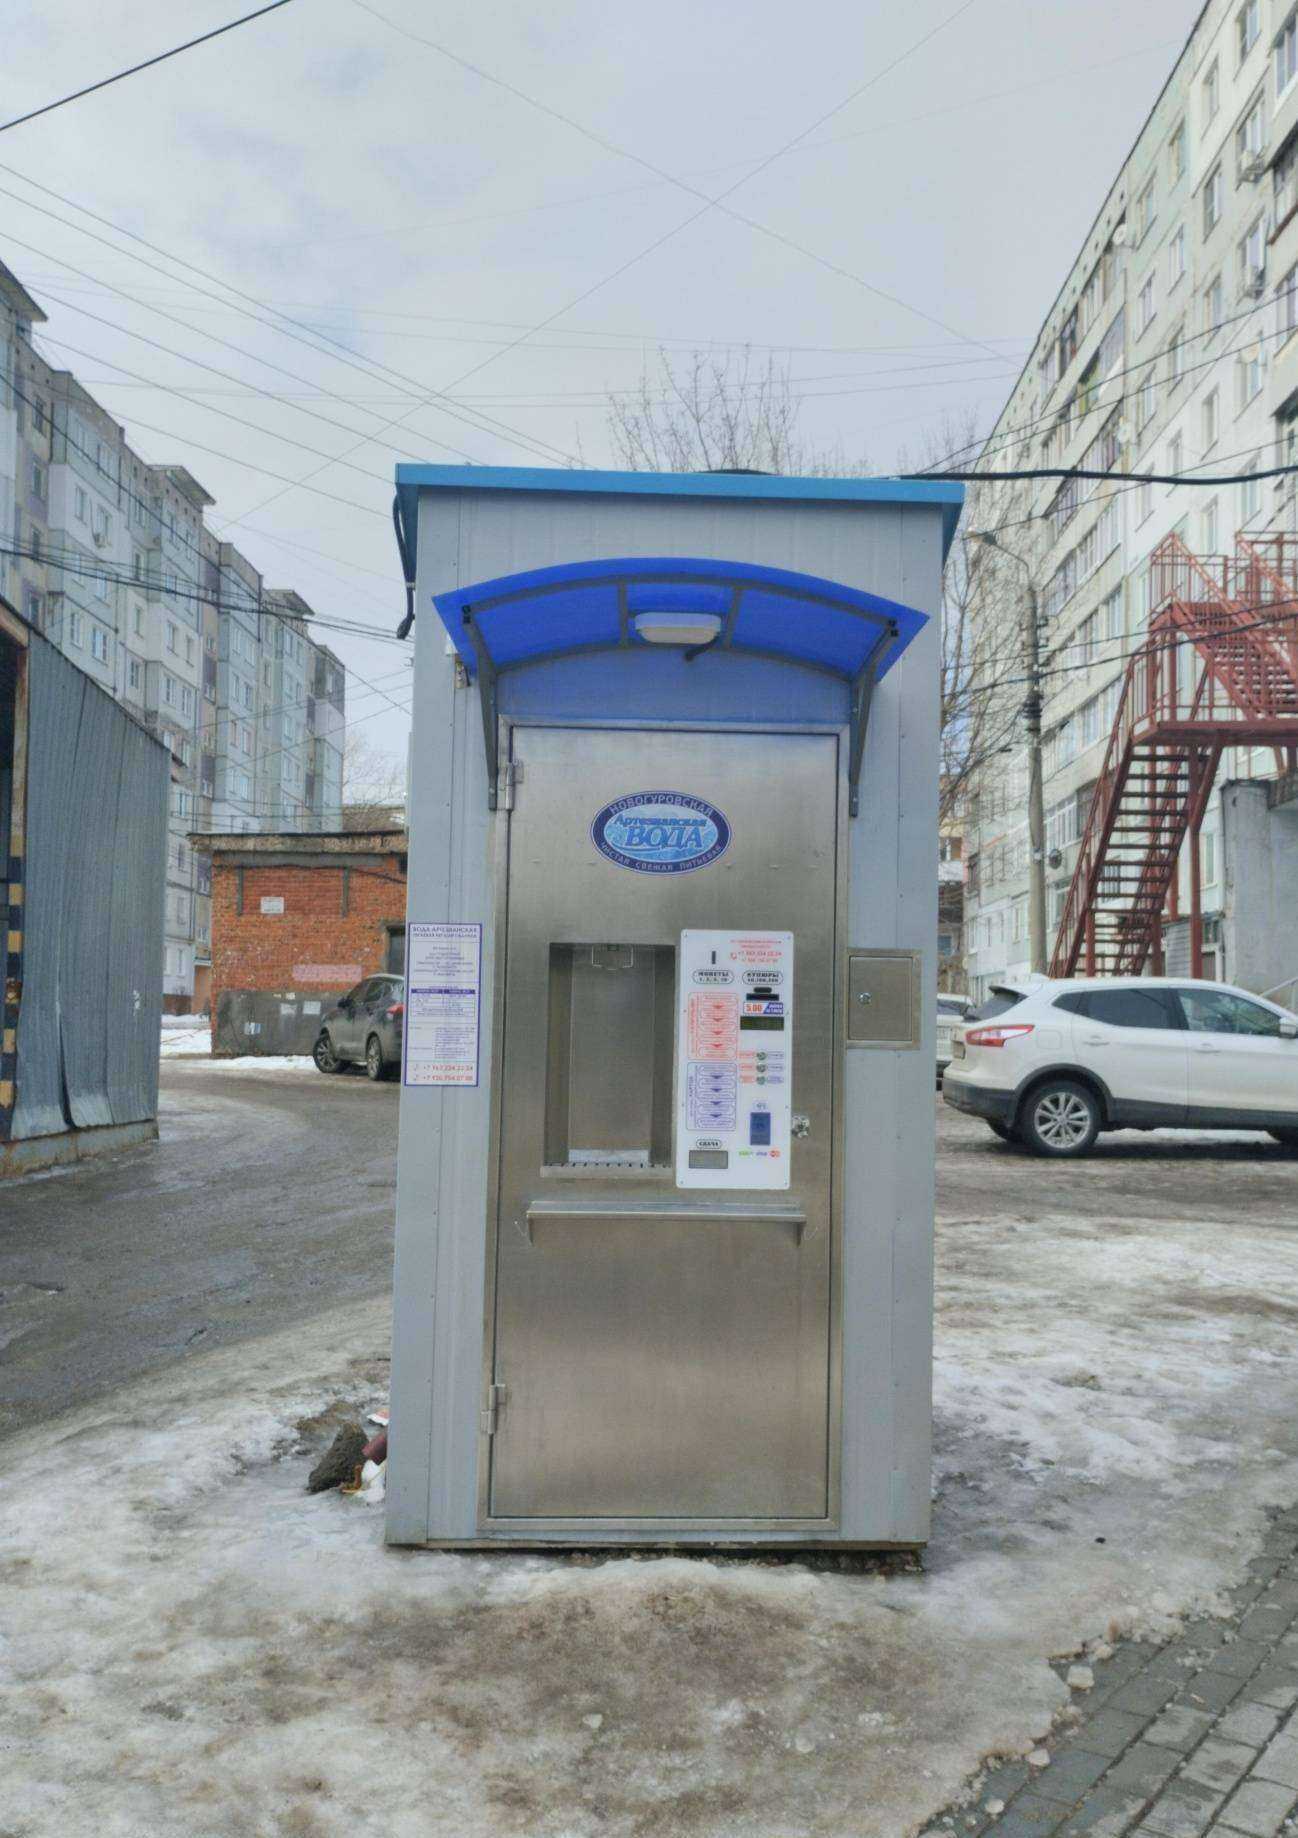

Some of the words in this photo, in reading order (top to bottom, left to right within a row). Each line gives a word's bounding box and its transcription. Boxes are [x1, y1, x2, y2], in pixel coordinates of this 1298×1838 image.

[609, 794, 714, 818] НОВОГУРОВСКАЯ
[625, 826, 703, 850] ВОДА
[601, 840, 630, 866] ЧИСТАЯ
[635, 861, 673, 872] СВЕЖАЯ
[680, 844, 722, 871] ПИТЬЕВАЯ
